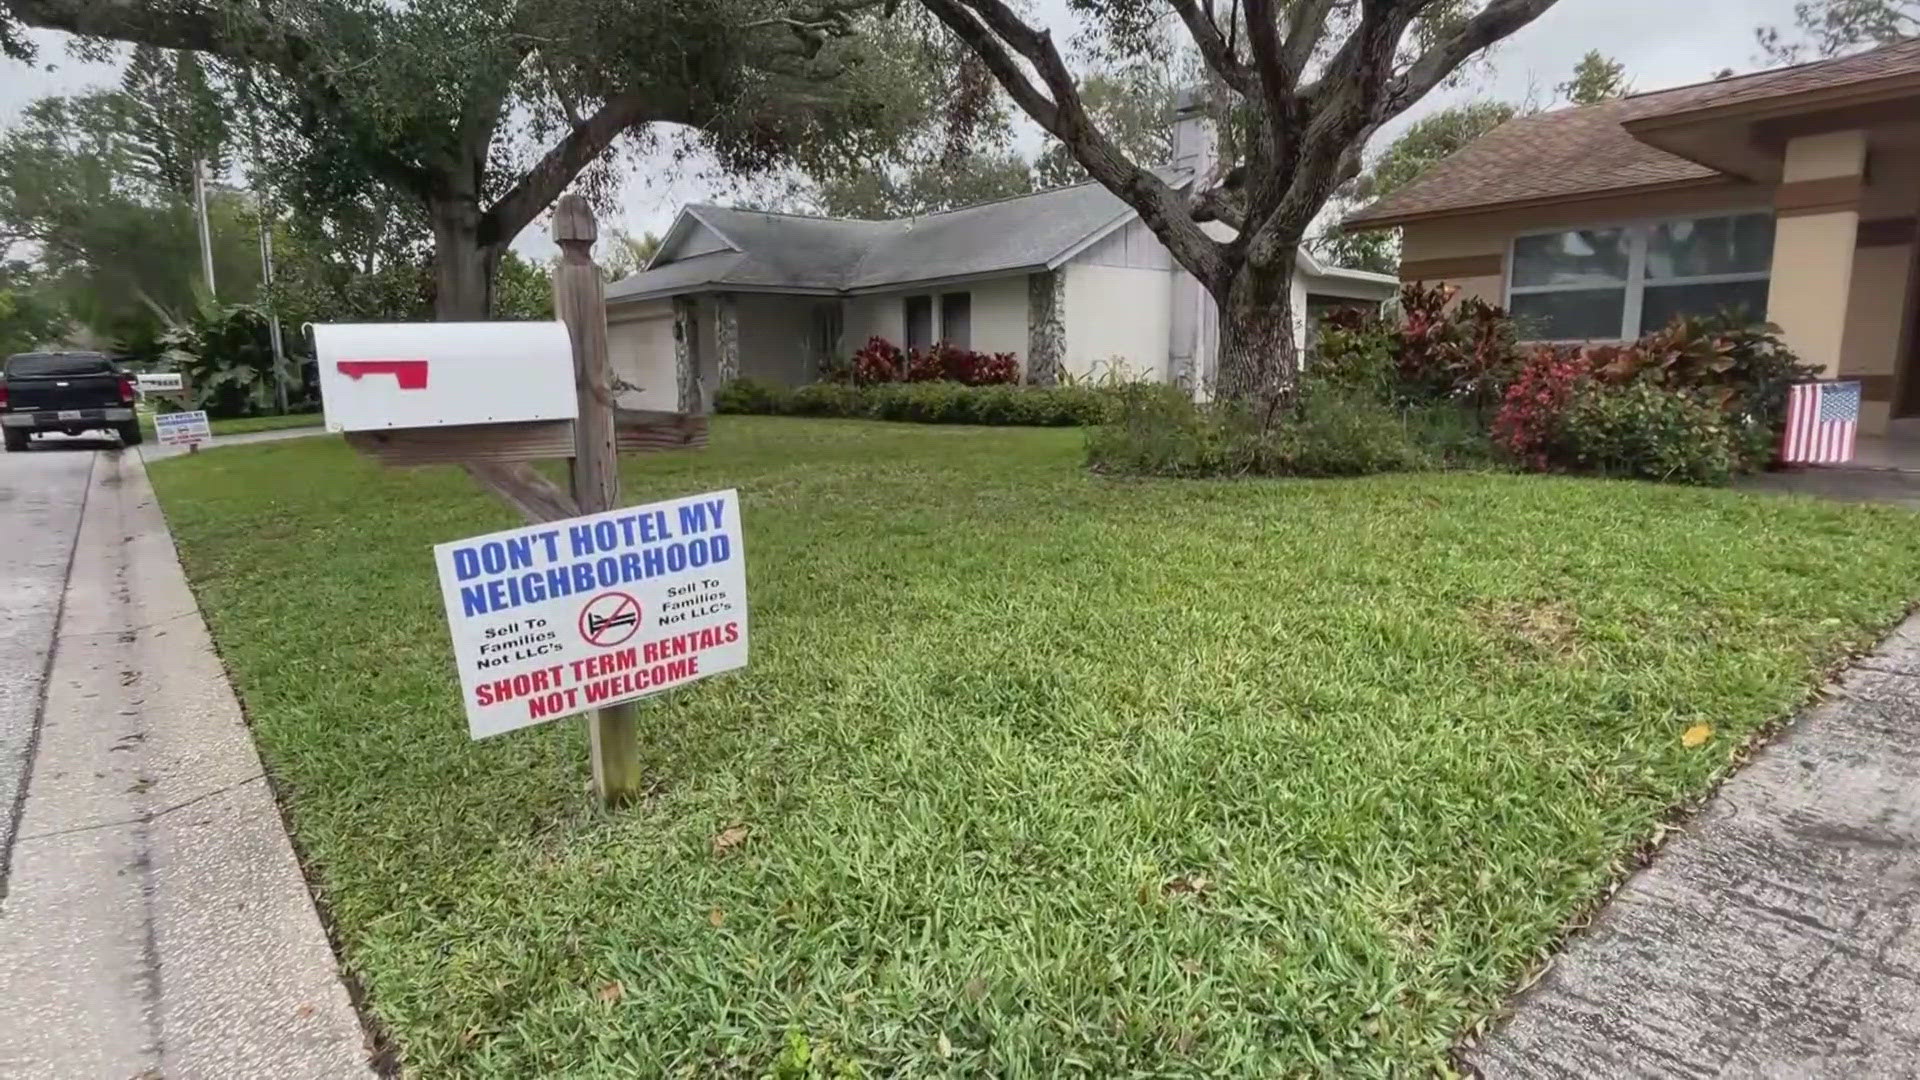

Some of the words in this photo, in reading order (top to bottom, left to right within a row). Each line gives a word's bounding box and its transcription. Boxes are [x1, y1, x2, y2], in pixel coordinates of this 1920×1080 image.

[452, 531, 560, 582] DON'T
[569, 510, 673, 555] HOTEL
[678, 499, 725, 535] MY
[460, 534, 731, 618] NEIGHBORHOOD
[667, 583, 697, 598] Sell
[702, 579, 720, 589] To
[659, 614, 686, 626] Not
[691, 602, 732, 619] LLC's
[662, 591, 726, 612] Families
[485, 623, 519, 639] Sell
[525, 618, 547, 629] To
[479, 631, 556, 655] Families
[475, 665, 564, 706] SHORT
[569, 648, 637, 681] TERM
[643, 622, 739, 664] RENTALS
[477, 656, 510, 670] Not
[515, 643, 563, 662] LLC's
[528, 690, 579, 719] NOT
[584, 656, 699, 702] WELCOME
